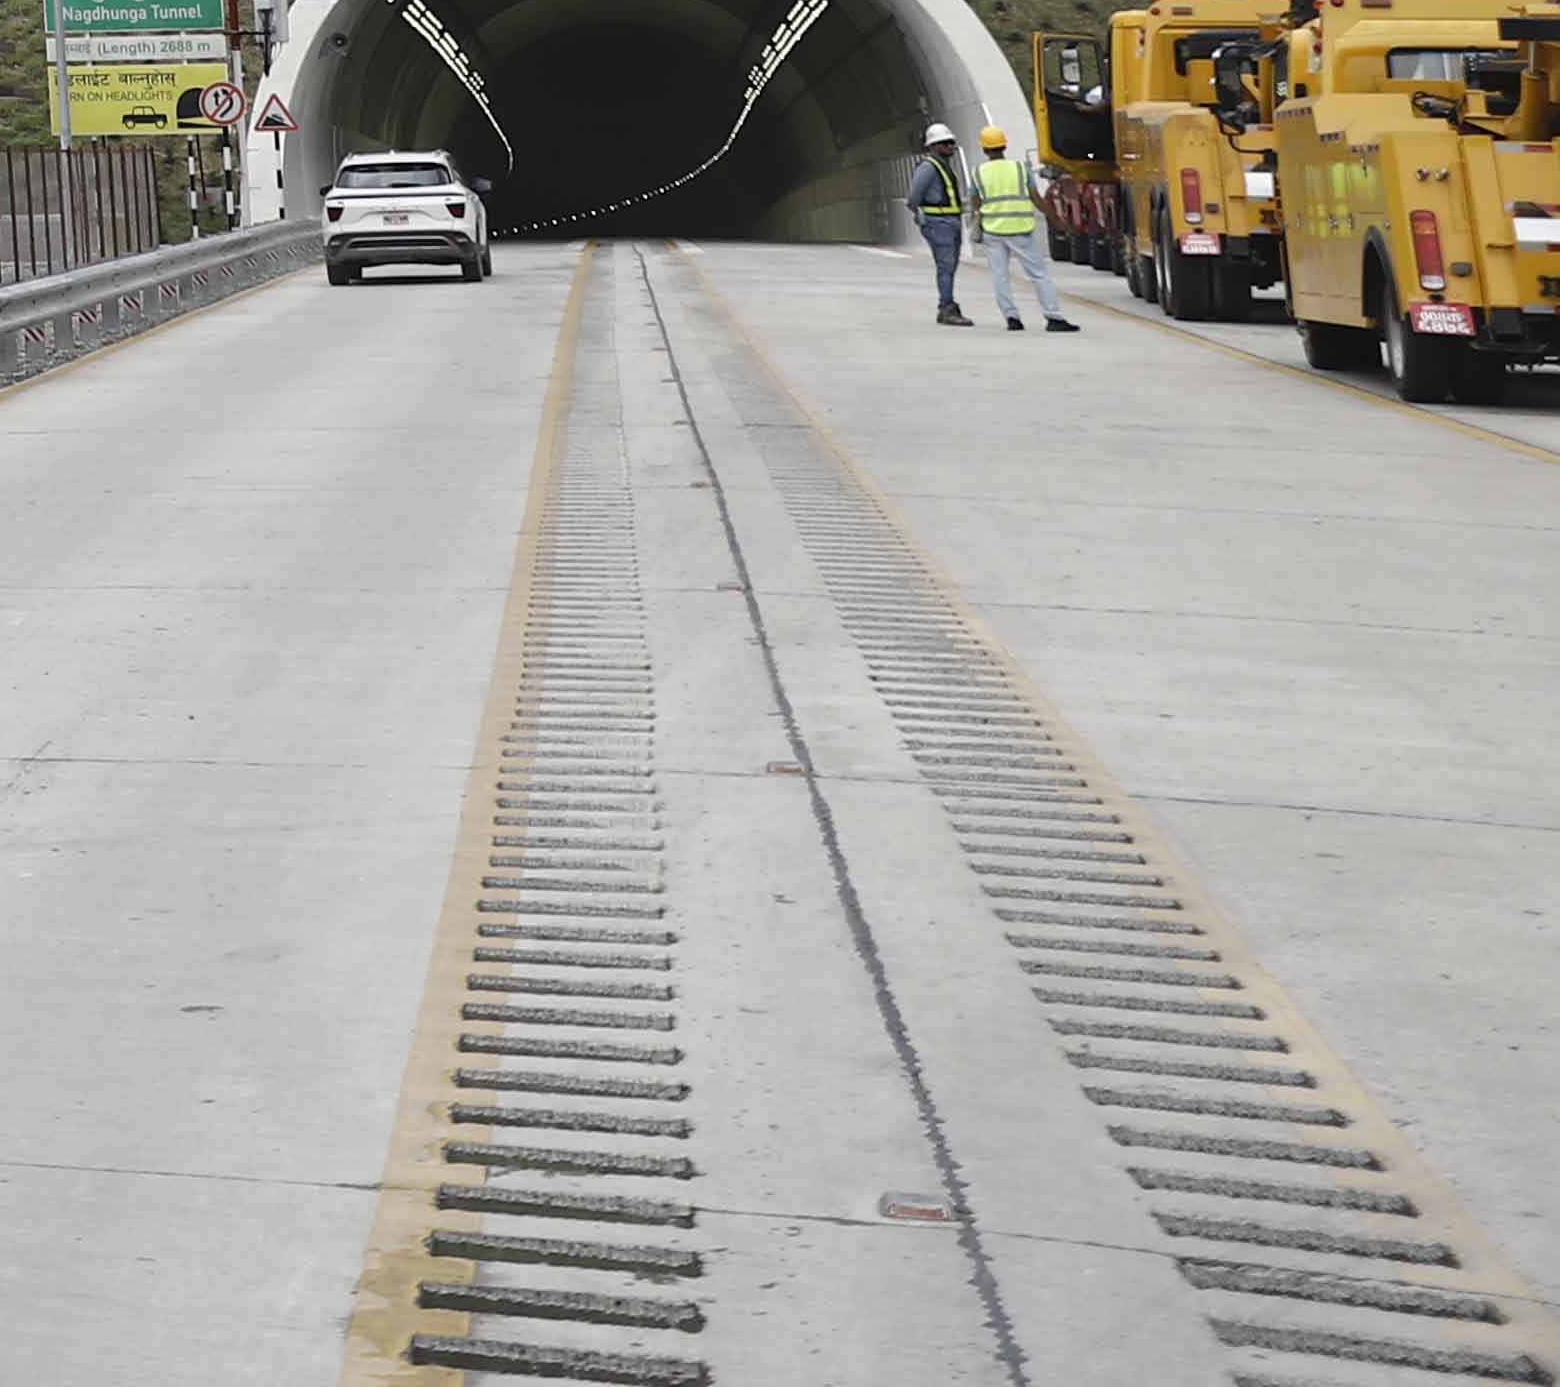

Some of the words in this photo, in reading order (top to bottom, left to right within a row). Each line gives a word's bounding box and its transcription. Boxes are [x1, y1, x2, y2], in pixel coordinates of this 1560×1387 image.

[62, 5, 147, 24] Nagdhunga
[151, 3, 202, 20] Tunnel
[97, 42, 156, 57] (Length)
[160, 41, 193, 53] 2688
[197, 42, 210, 52] m
[87, 91, 103, 102] ON
[105, 90, 173, 101] HEADLIGHTS
